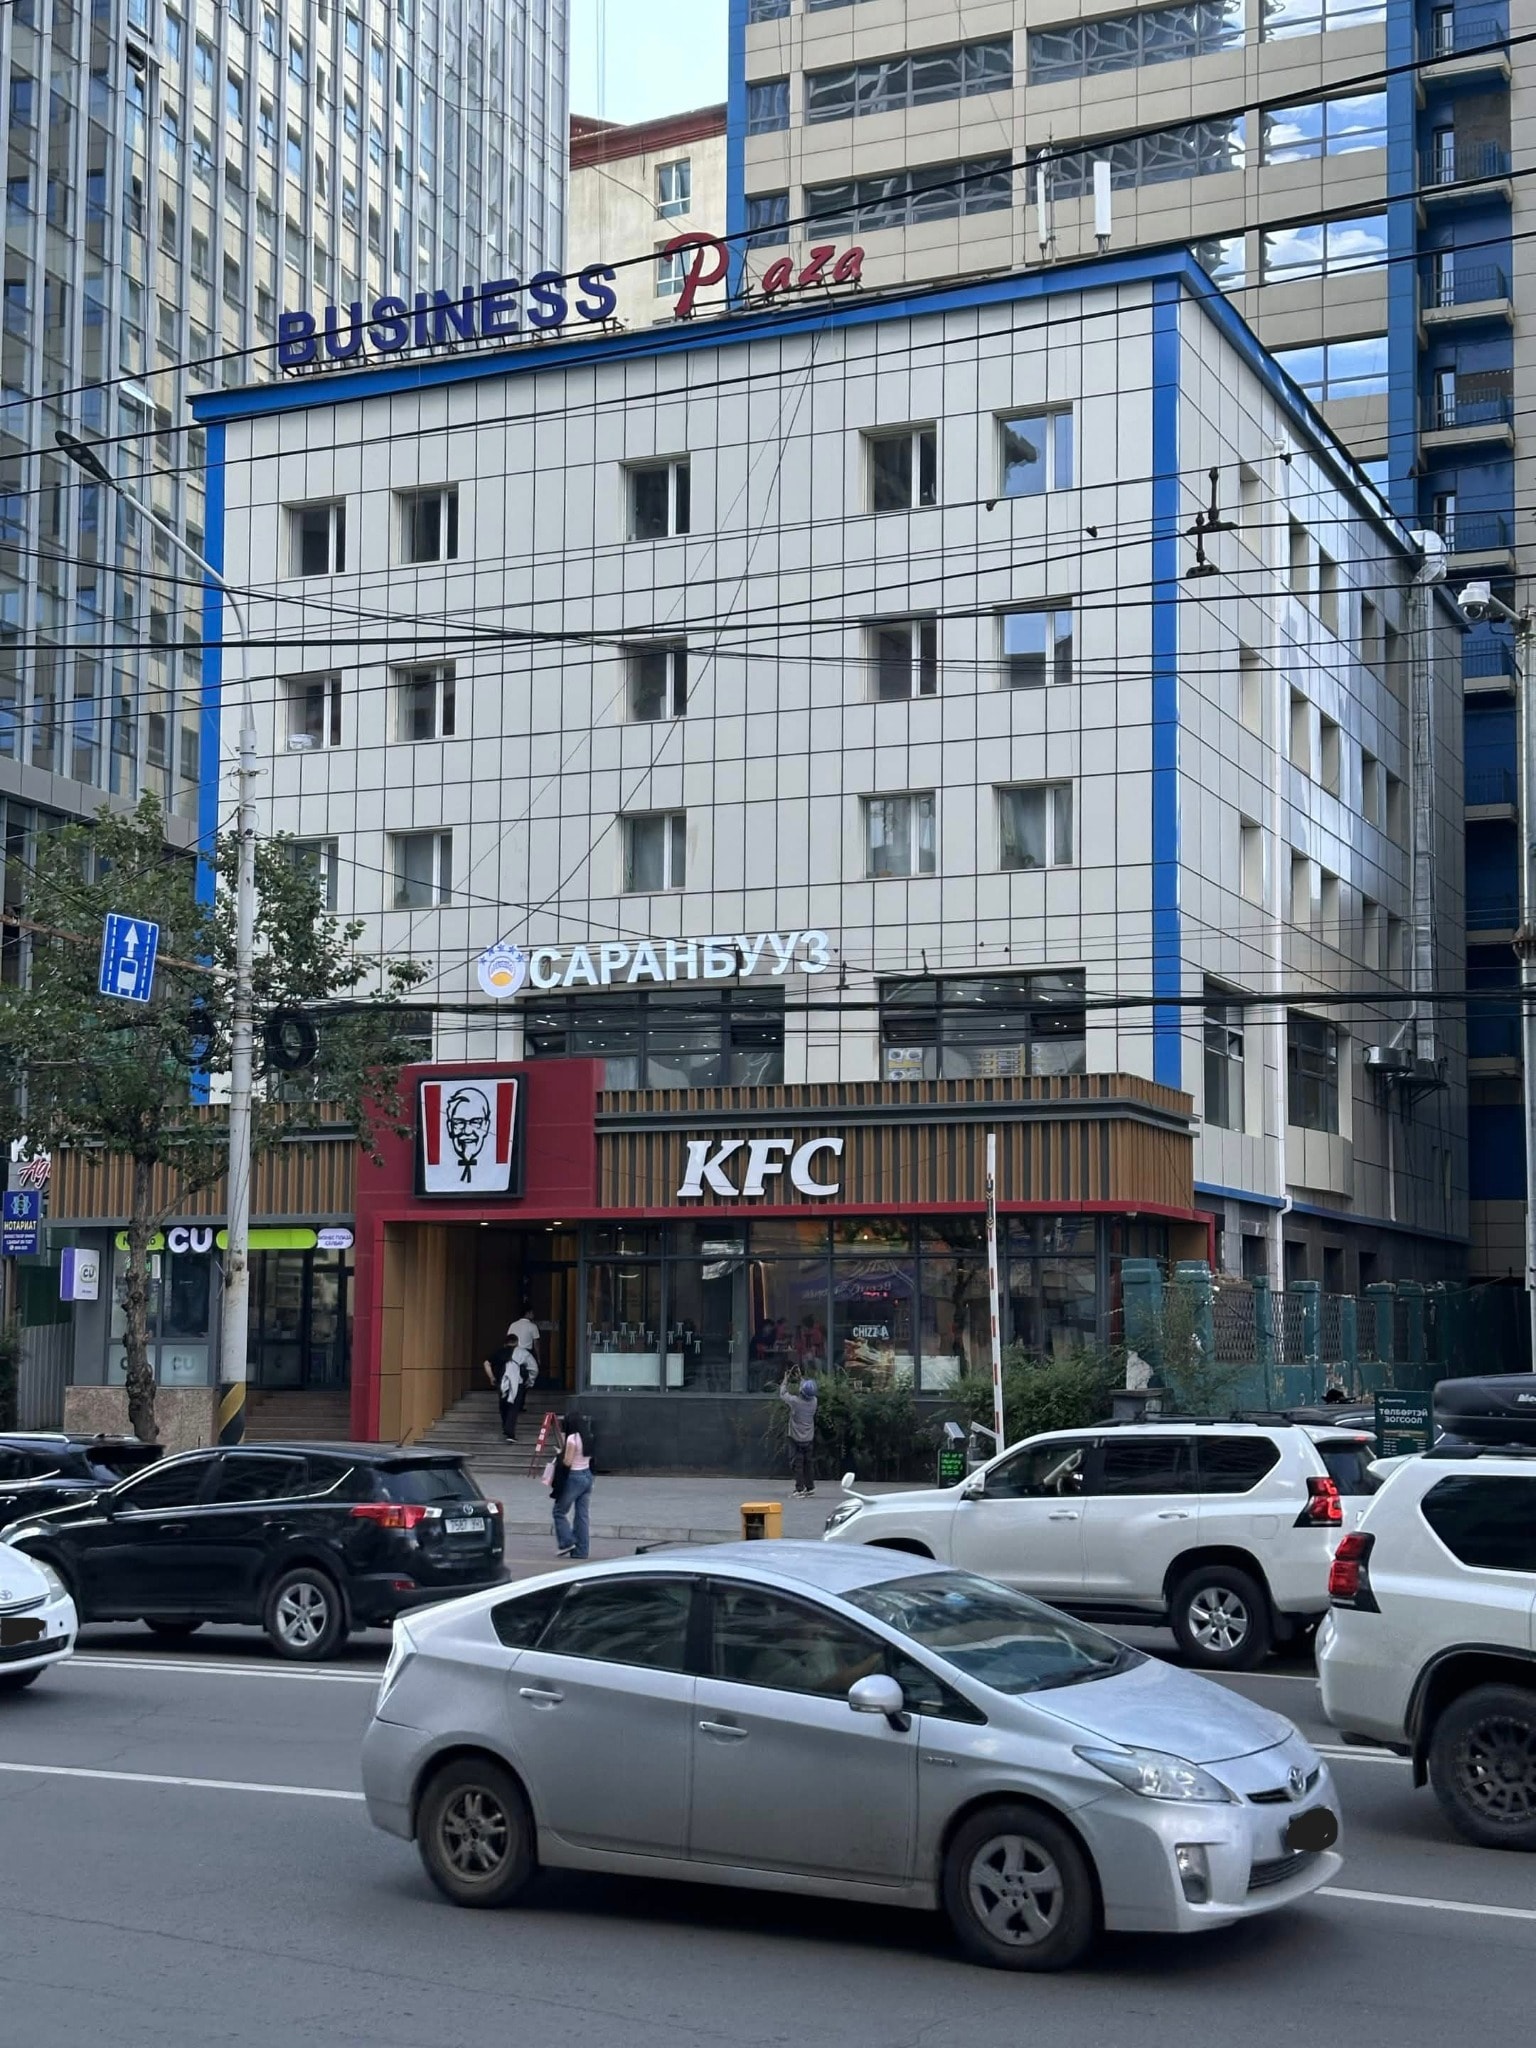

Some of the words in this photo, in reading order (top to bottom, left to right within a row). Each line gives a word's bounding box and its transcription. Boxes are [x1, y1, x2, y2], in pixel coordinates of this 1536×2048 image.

[279, 262, 617, 367] BUSINESS
[529, 930, 831, 989] САРАНБУУЗ
[676, 1137, 844, 1197] KFC
[4, 1221, 37, 1231] НОТАРИАТ
[168, 1227, 213, 1253] CU
[1385, 1416, 1423, 1424] ЗОГСООЛ
